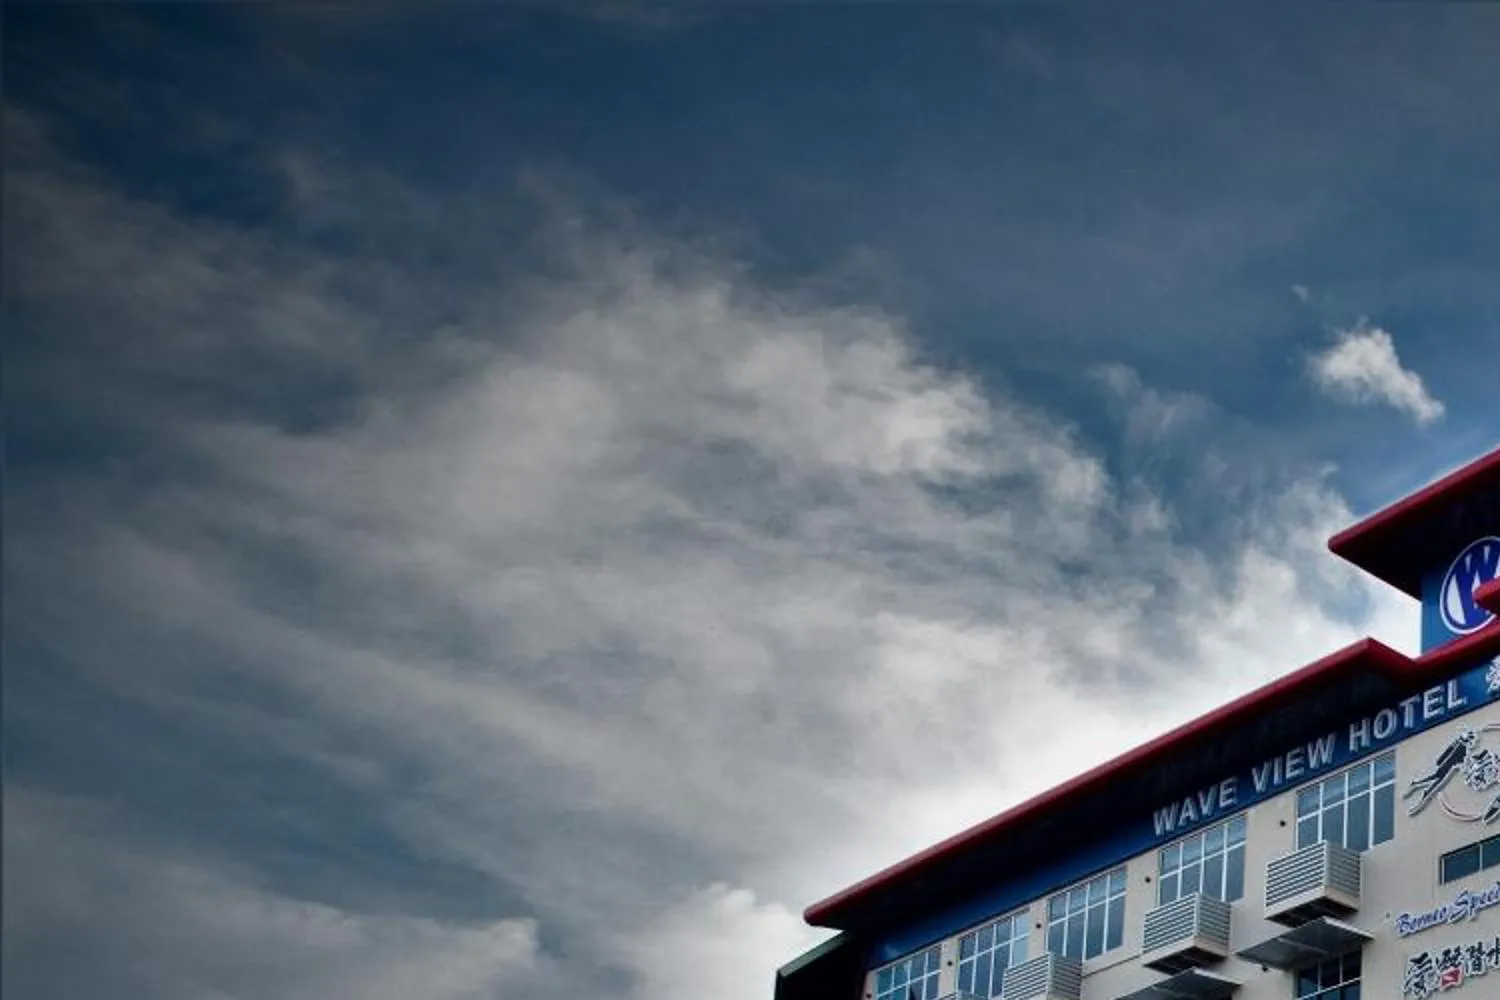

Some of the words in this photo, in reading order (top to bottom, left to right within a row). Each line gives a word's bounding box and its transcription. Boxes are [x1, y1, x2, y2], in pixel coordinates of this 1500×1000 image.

[1153, 776, 1239, 836] WAVE
[1251, 732, 1338, 793] VIEW
[1349, 680, 1469, 752] HOTEL
[1396, 908, 1447, 933] Borneo
